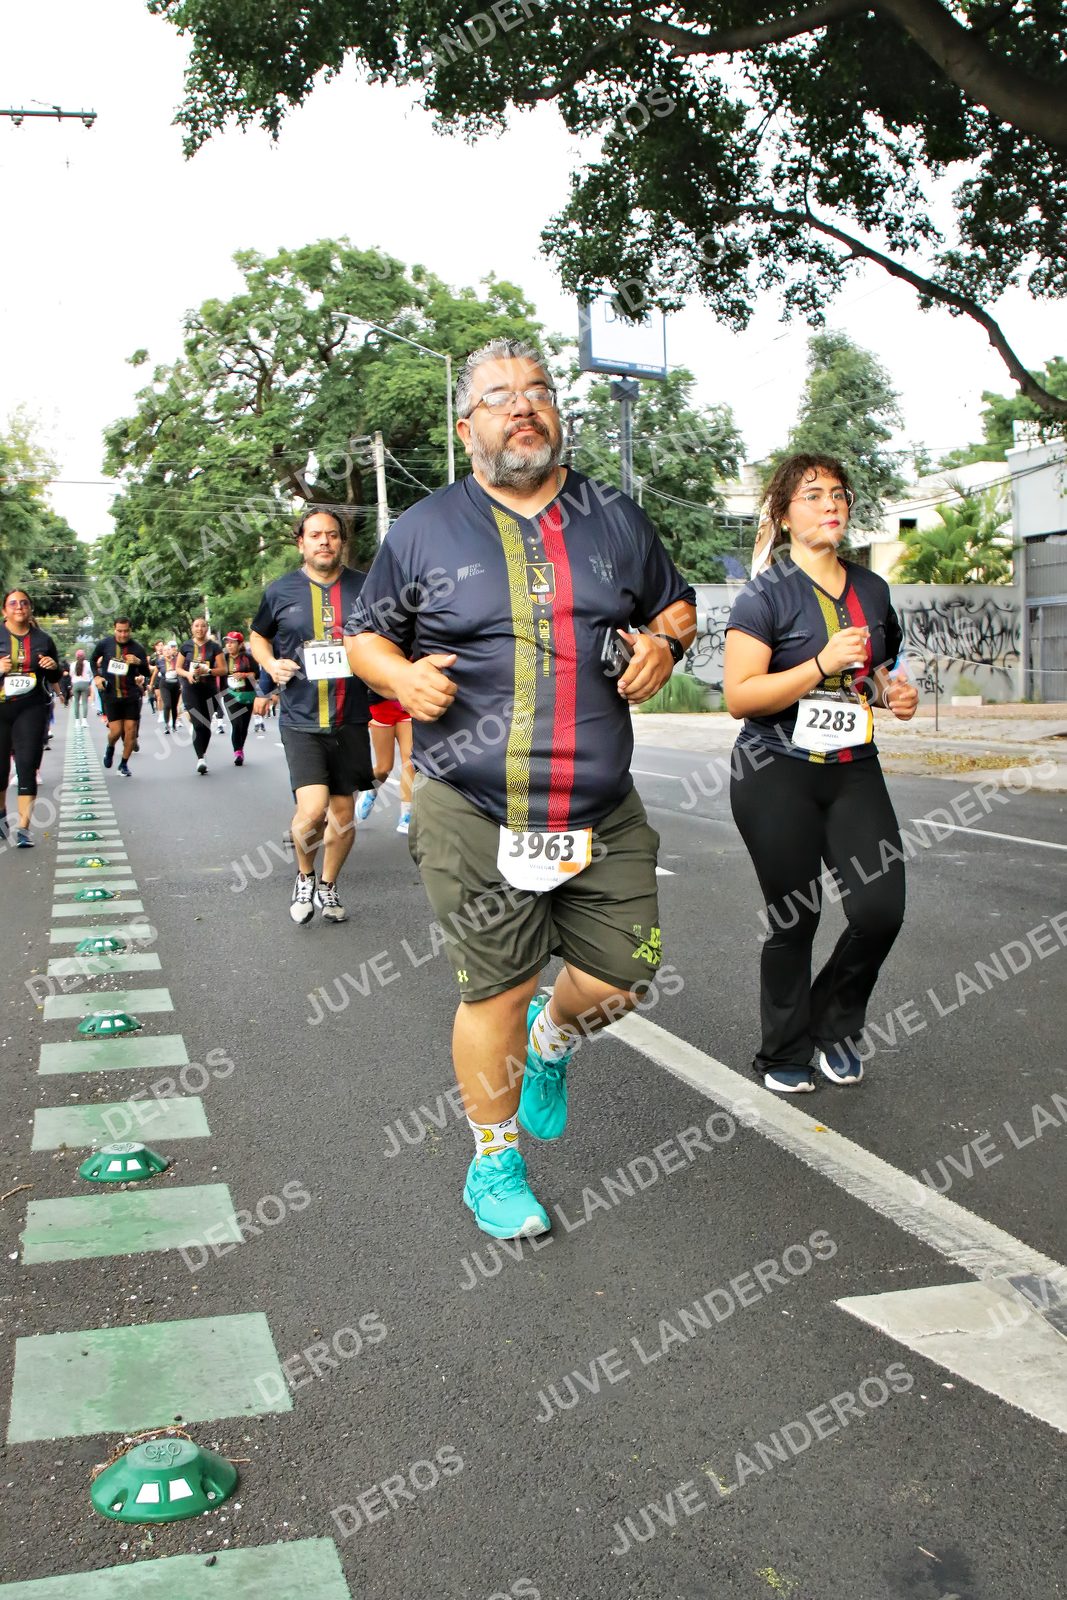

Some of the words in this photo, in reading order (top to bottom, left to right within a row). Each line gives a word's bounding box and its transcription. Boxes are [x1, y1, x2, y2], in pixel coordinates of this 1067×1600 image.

[312, 651, 342, 665] 1451
[9, 679, 31, 688] 4279
[806, 707, 857, 732] 2283
[509, 832, 575, 862] 3963
